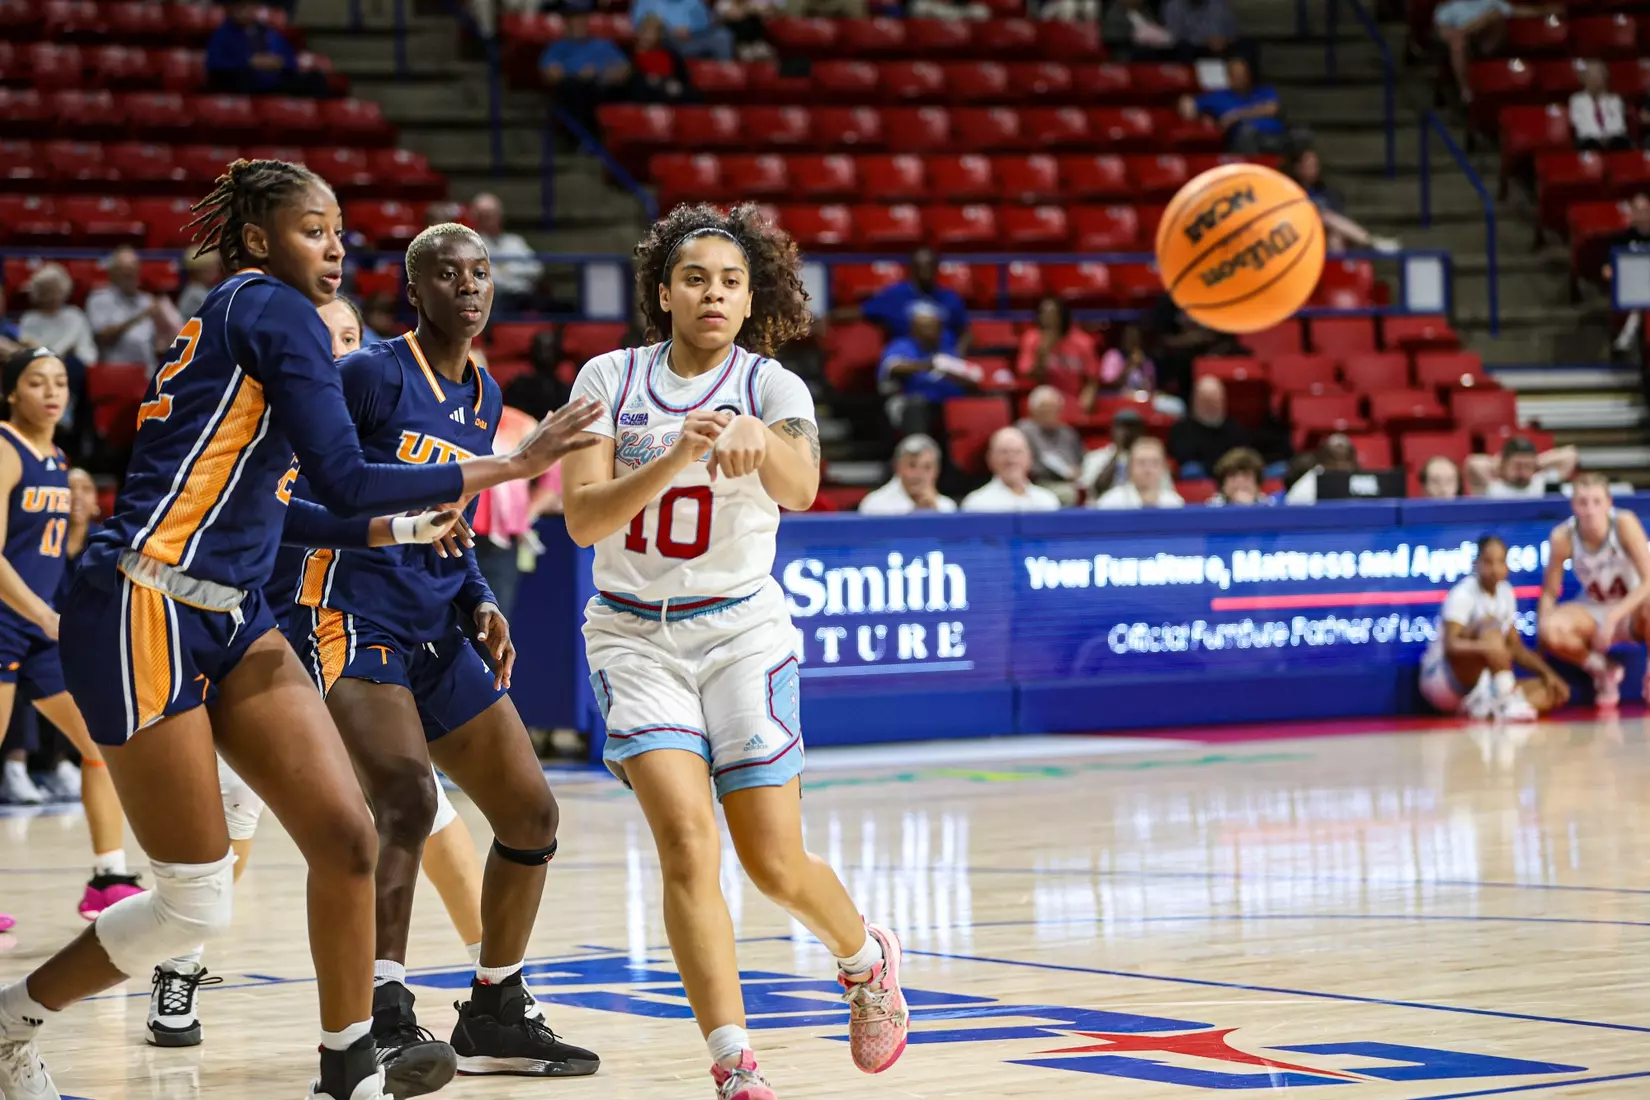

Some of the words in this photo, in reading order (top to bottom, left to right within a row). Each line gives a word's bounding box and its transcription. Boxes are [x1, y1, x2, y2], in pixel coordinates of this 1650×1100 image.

[1184, 184, 1256, 245] NCAA
[1200, 221, 1299, 288] Wilson
[39, 518, 67, 558] 11
[624, 485, 713, 560] 10
[783, 551, 969, 617] Smith
[1358, 543, 1410, 578] and
